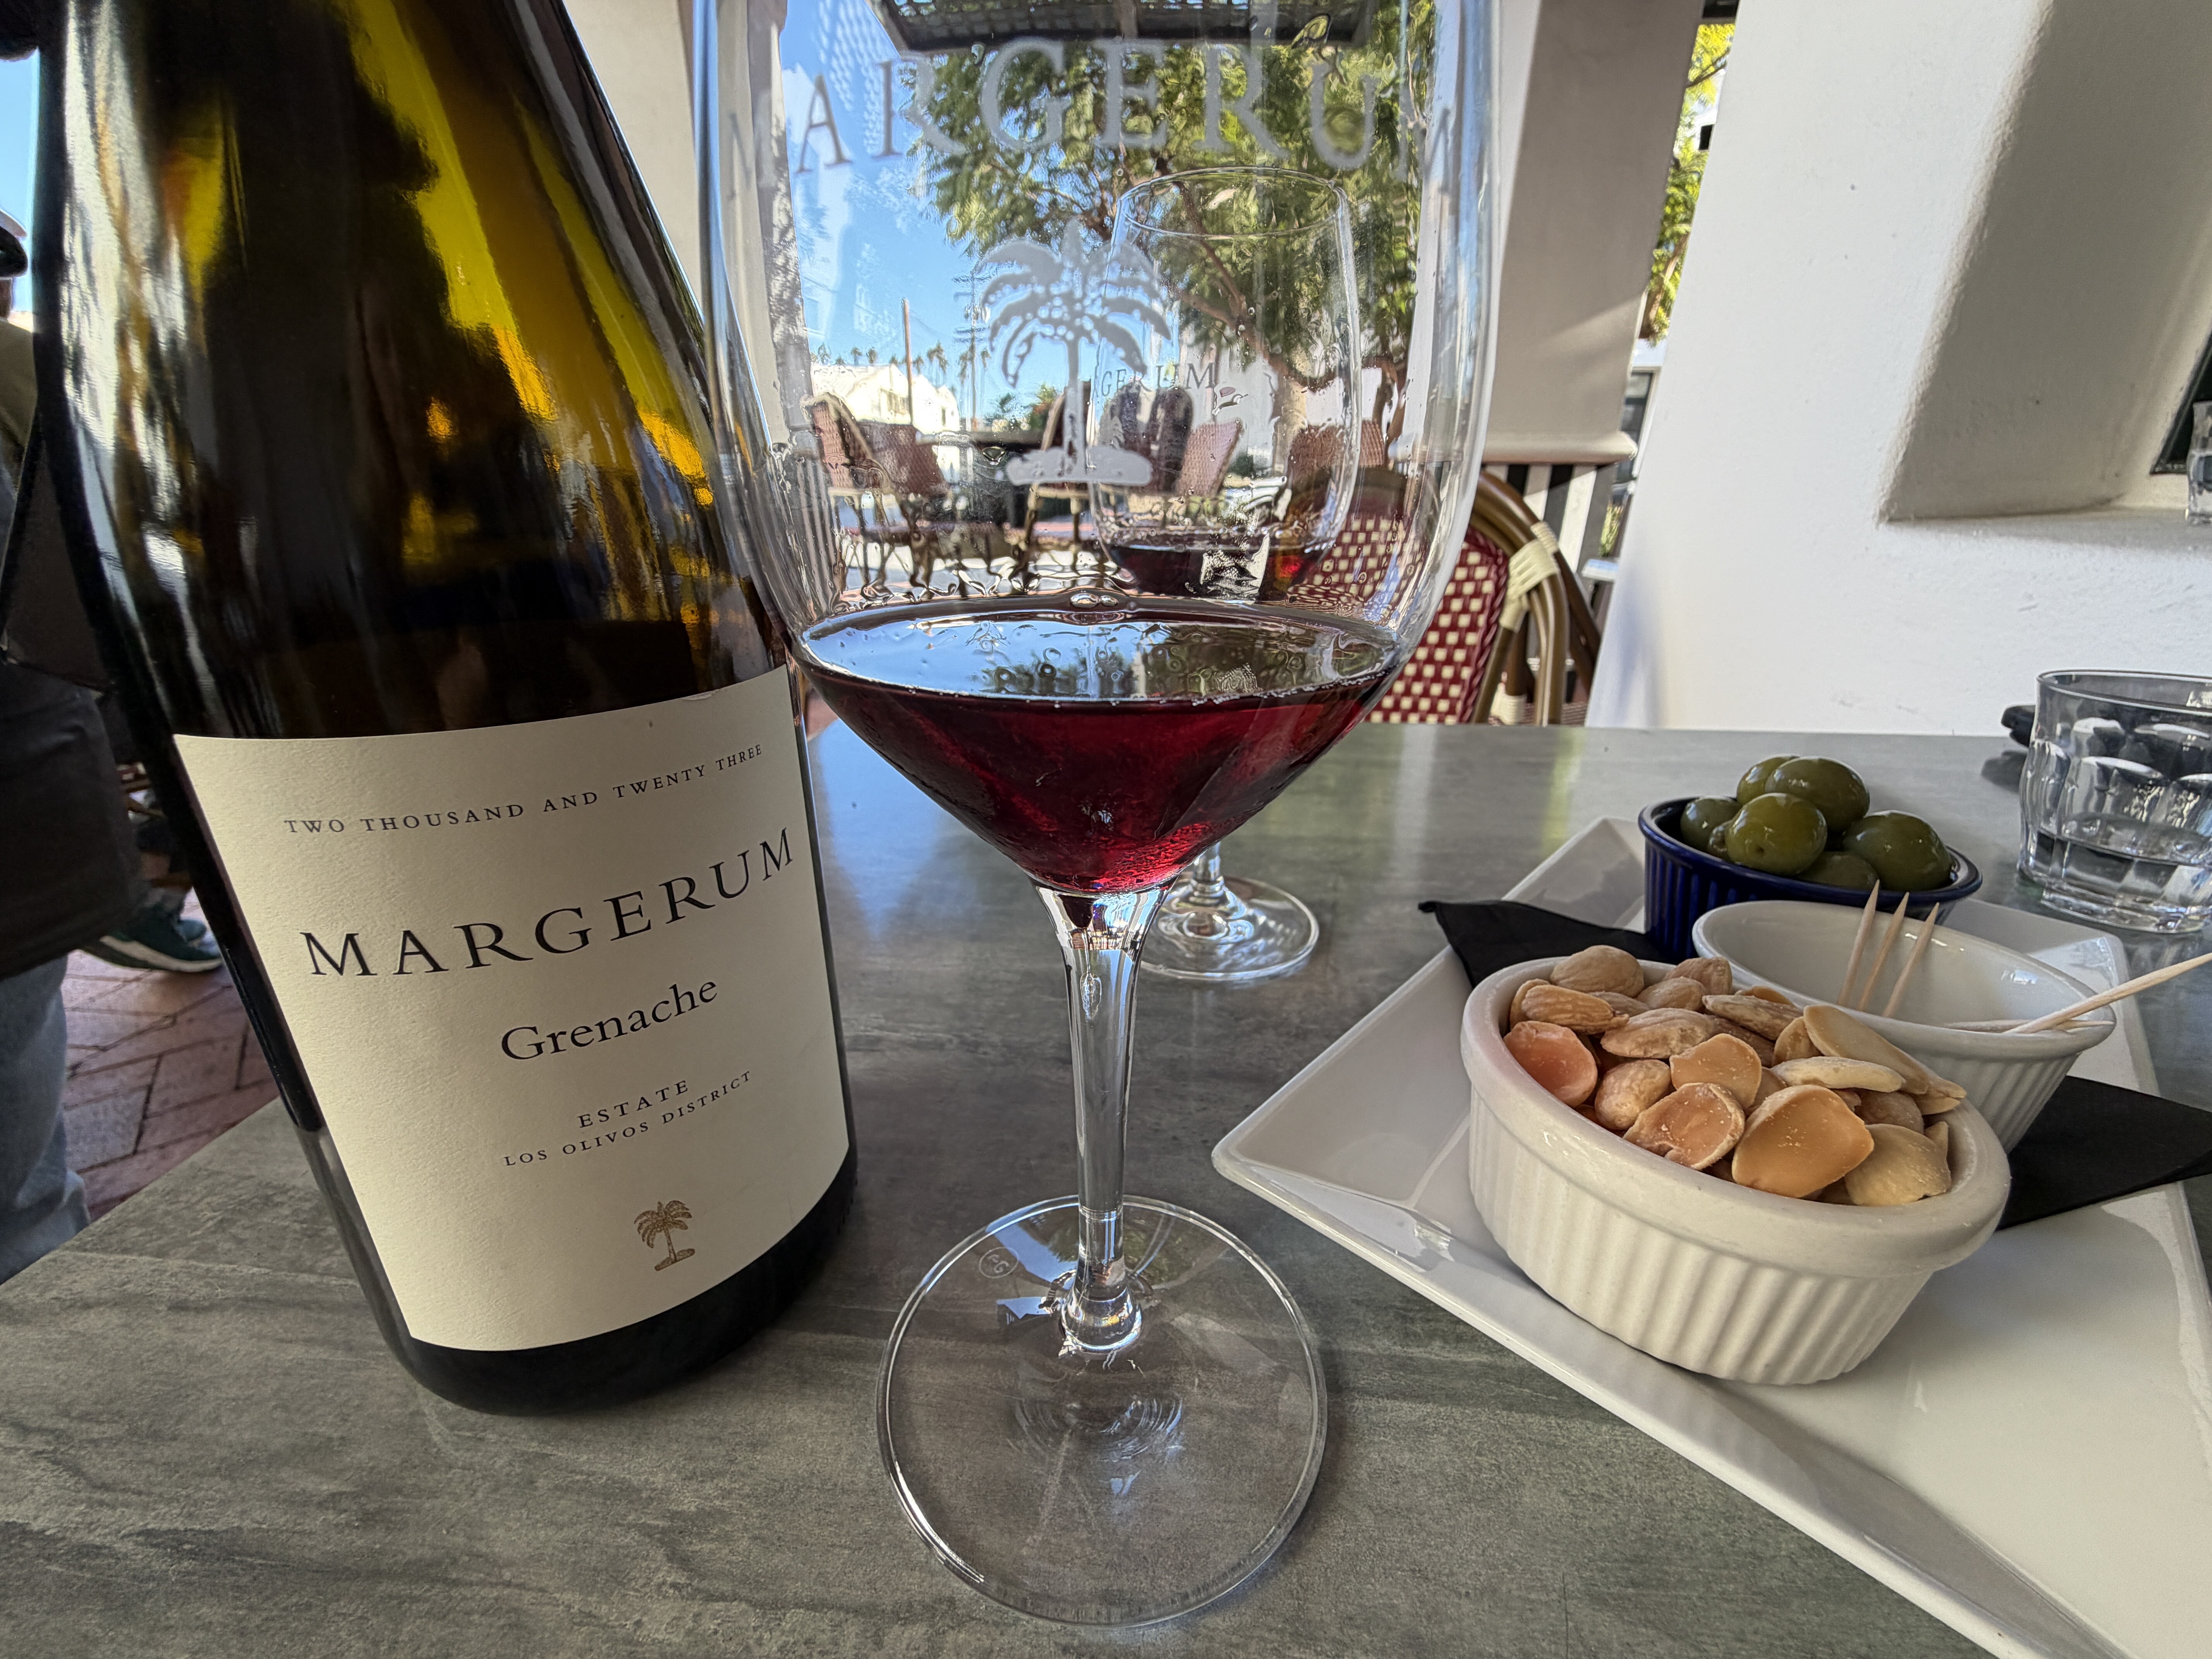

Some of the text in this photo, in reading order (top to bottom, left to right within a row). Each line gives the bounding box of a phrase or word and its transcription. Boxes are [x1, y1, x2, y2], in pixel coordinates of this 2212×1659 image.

[283, 744, 762, 833] TWO THOUSAND AND TWENTY THREE
[299, 827, 793, 976] MARGERUM
[501, 981, 718, 1060] Grenache
[503, 1070, 750, 1166] LOS OLIVOS DISTRICT
[577, 1080, 689, 1128] ESTATE
